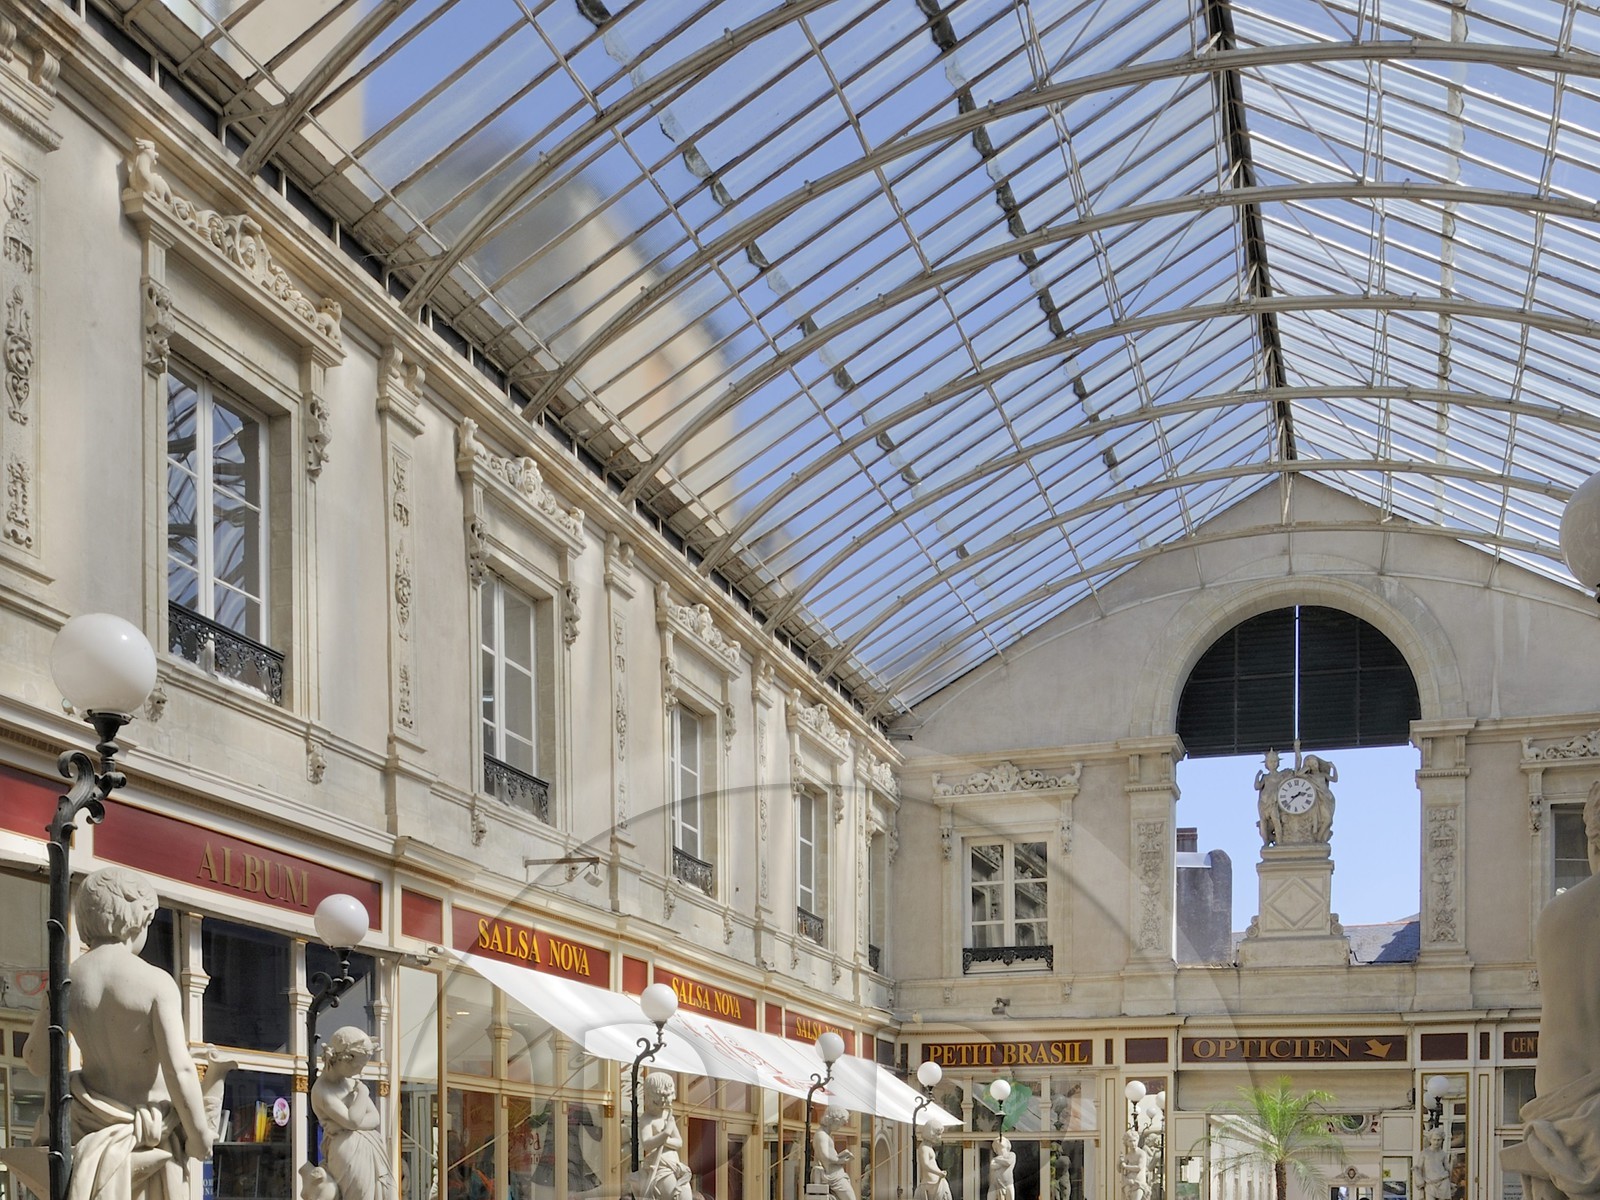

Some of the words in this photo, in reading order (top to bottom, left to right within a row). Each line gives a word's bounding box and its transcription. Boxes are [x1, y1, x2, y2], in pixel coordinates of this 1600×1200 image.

[196, 841, 310, 908] ALBUM
[478, 918, 541, 963] SALSA
[548, 939, 591, 977] NOVA
[672, 977, 711, 1010] SALSA
[714, 991, 742, 1019] NOVA
[928, 1043, 996, 1066] PETIT
[1002, 1042, 1088, 1065] BRASIL
[1192, 1039, 1351, 1059] OPTICIEN
